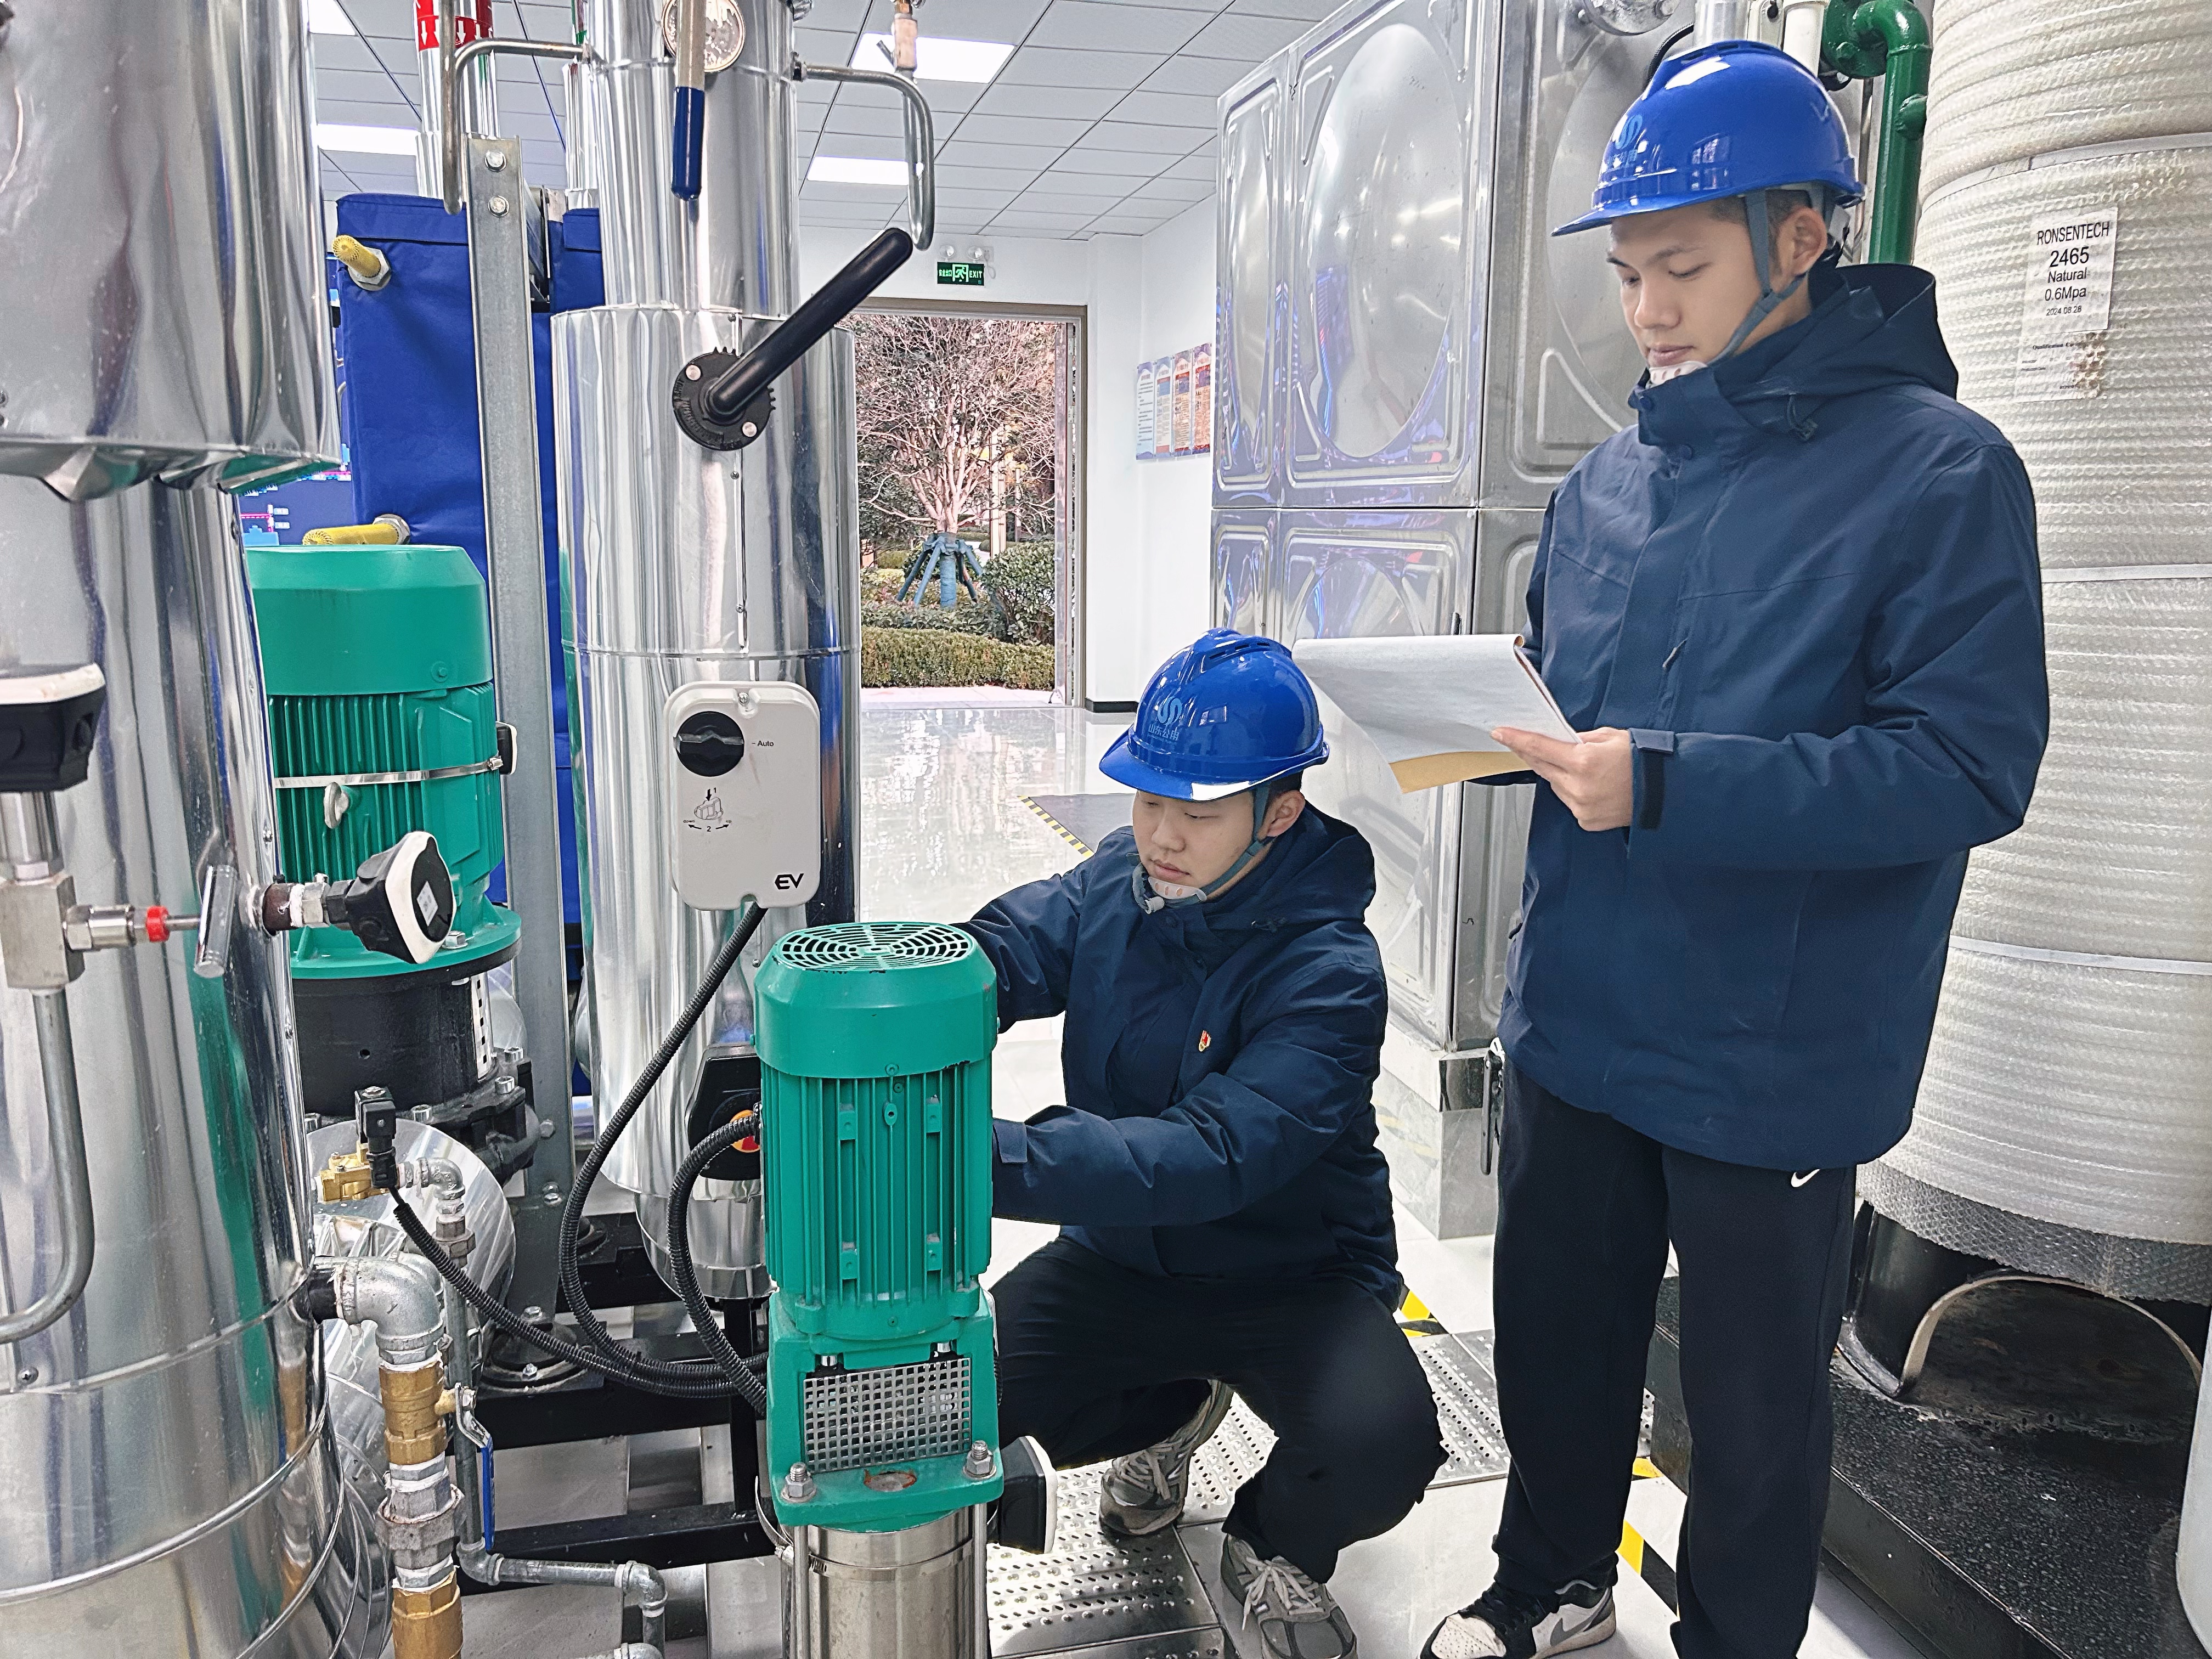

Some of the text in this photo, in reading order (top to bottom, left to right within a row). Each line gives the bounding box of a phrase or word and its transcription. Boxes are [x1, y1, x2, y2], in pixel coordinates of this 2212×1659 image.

[2037, 221, 2109, 245] RONSENTECH
[2050, 246, 2089, 268] 2465
[2047, 268, 2087, 284] Natural
[2045, 286, 2087, 301] 0.6Mpa
[775, 873, 804, 890] EV
